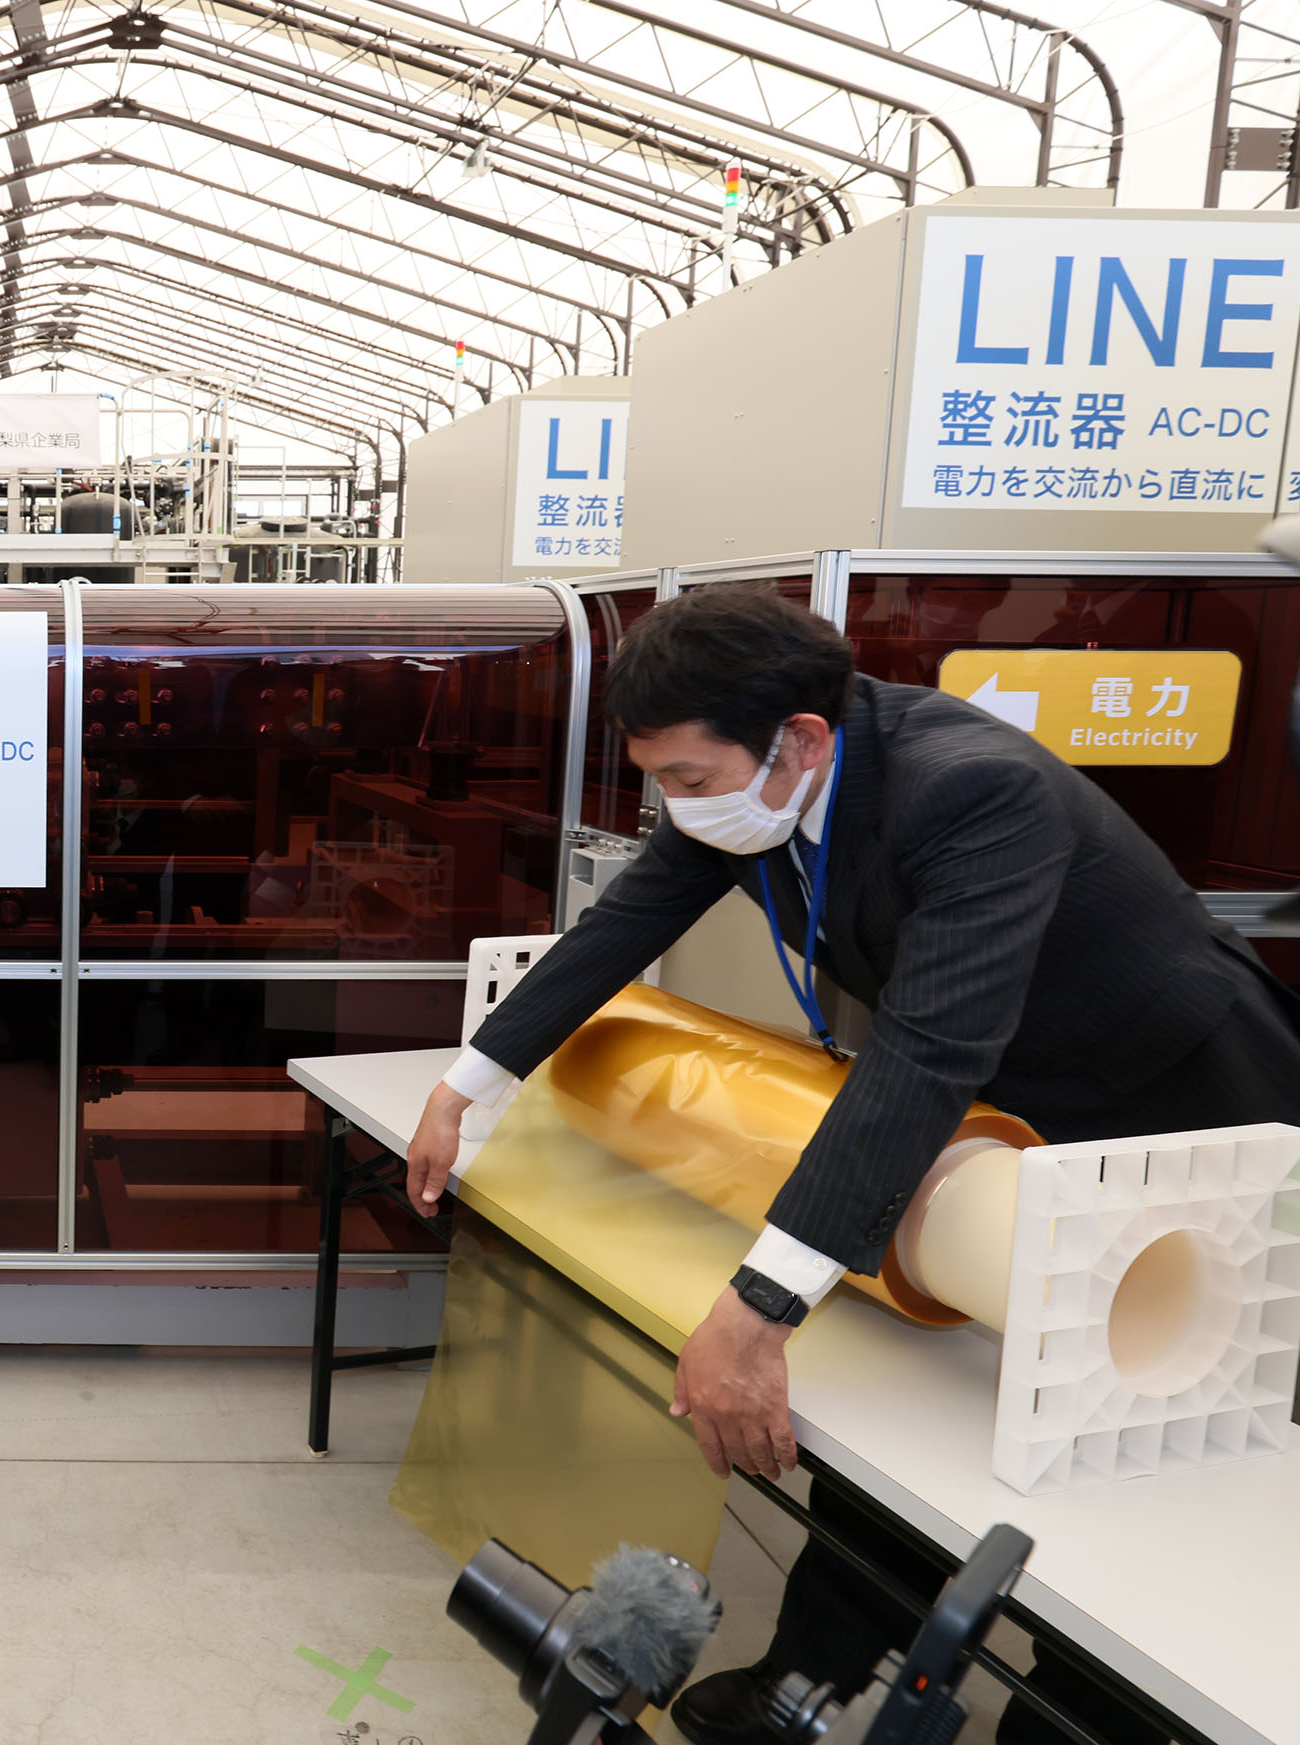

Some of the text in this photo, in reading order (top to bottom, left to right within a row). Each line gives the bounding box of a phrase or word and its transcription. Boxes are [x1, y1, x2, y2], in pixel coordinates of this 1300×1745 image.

[956, 254, 1284, 369] LINE
[937, 389, 1270, 450] 整流器 AC-DC
[546, 417, 629, 480] LI
[933, 464, 1266, 501] 電力を交流から直流に
[1091, 677, 1191, 718] 電力
[1070, 728, 1198, 750] Electricity
